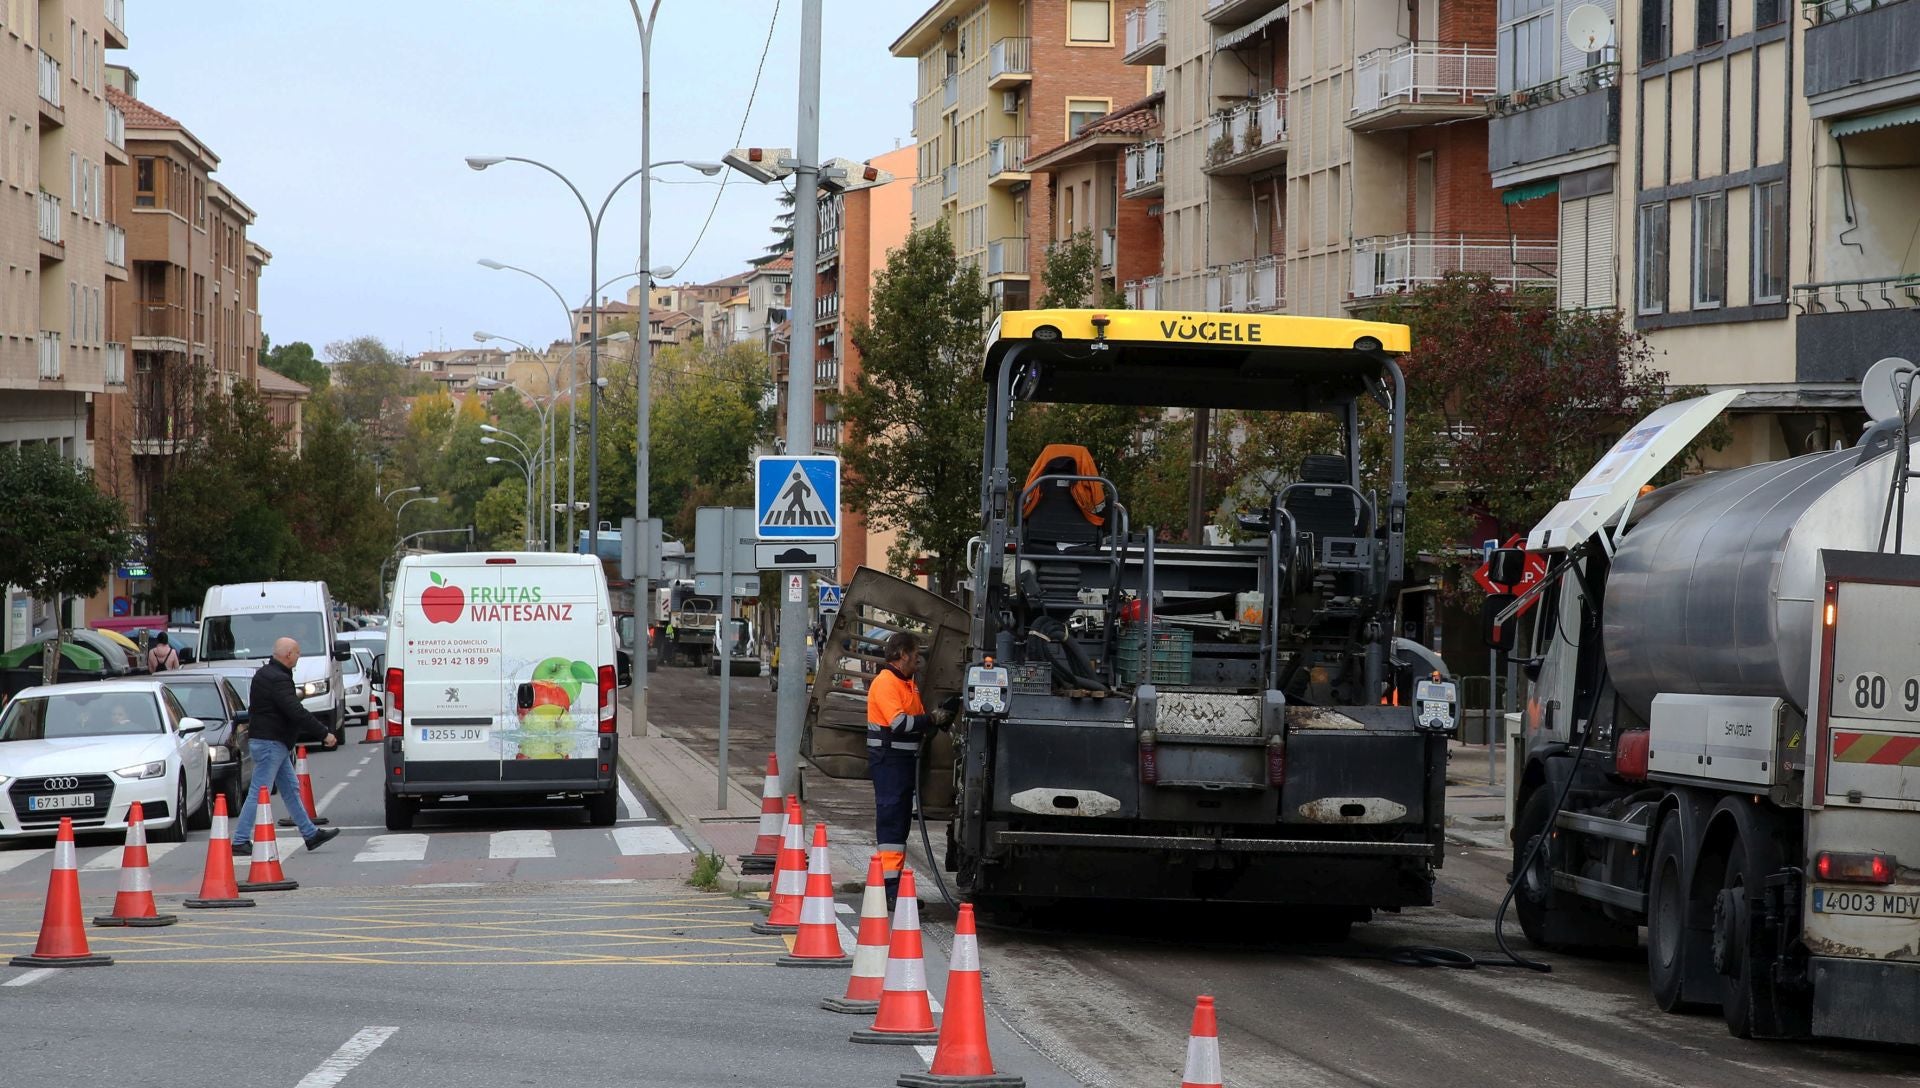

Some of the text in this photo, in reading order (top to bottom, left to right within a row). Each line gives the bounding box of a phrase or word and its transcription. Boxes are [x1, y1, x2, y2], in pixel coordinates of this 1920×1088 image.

[1160, 315, 1261, 342] VÖGELE
[471, 586, 541, 603] FRUTAS
[471, 604, 572, 622] MATESANZ
[431, 657, 448, 665] 921
[451, 657, 462, 665] 42
[465, 657, 475, 665] 18
[478, 657, 489, 665] 99
[1855, 675, 1886, 709] 80
[429, 729, 480, 739] 3255 JDV
[37, 795, 92, 808] 6731 JLB
[1826, 893, 1919, 914] 4003 MDV
